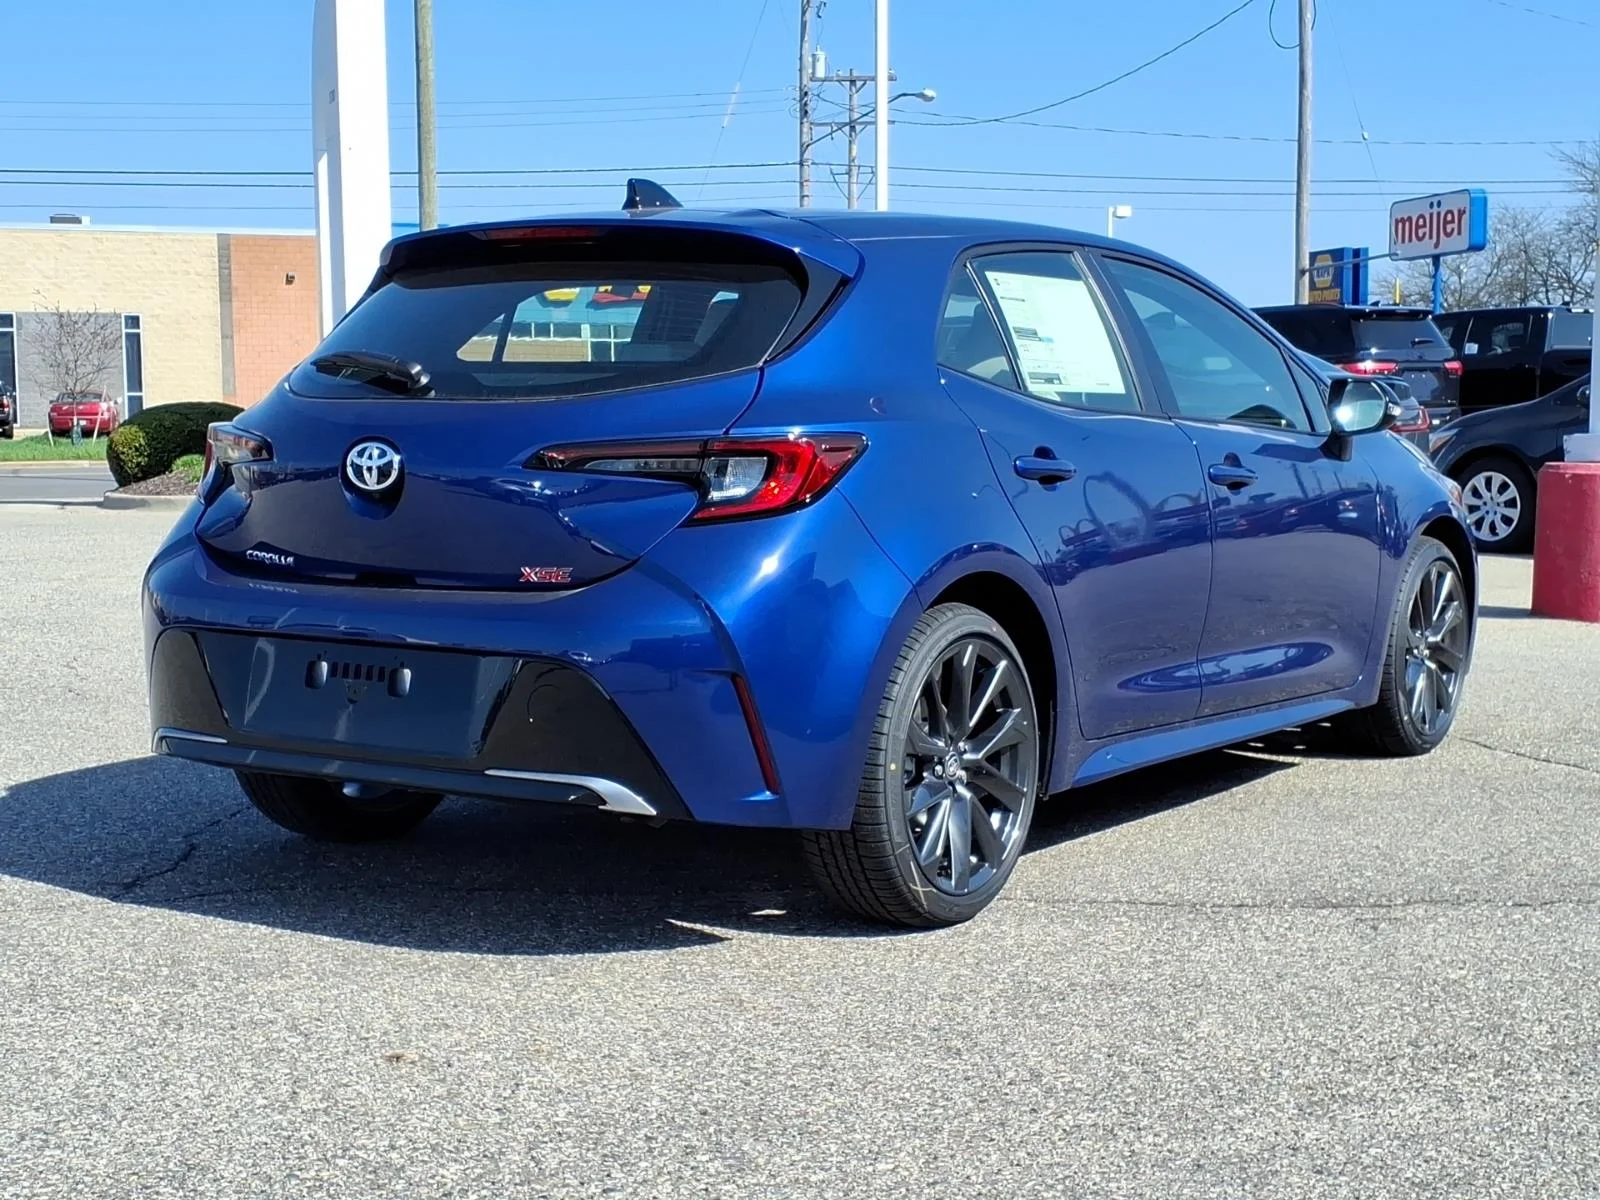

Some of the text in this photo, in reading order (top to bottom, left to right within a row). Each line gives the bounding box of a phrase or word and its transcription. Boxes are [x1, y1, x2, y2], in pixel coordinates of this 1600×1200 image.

[1393, 200, 1467, 249] meijer
[246, 550, 295, 566] COROLLA
[519, 567, 573, 583] XSE
